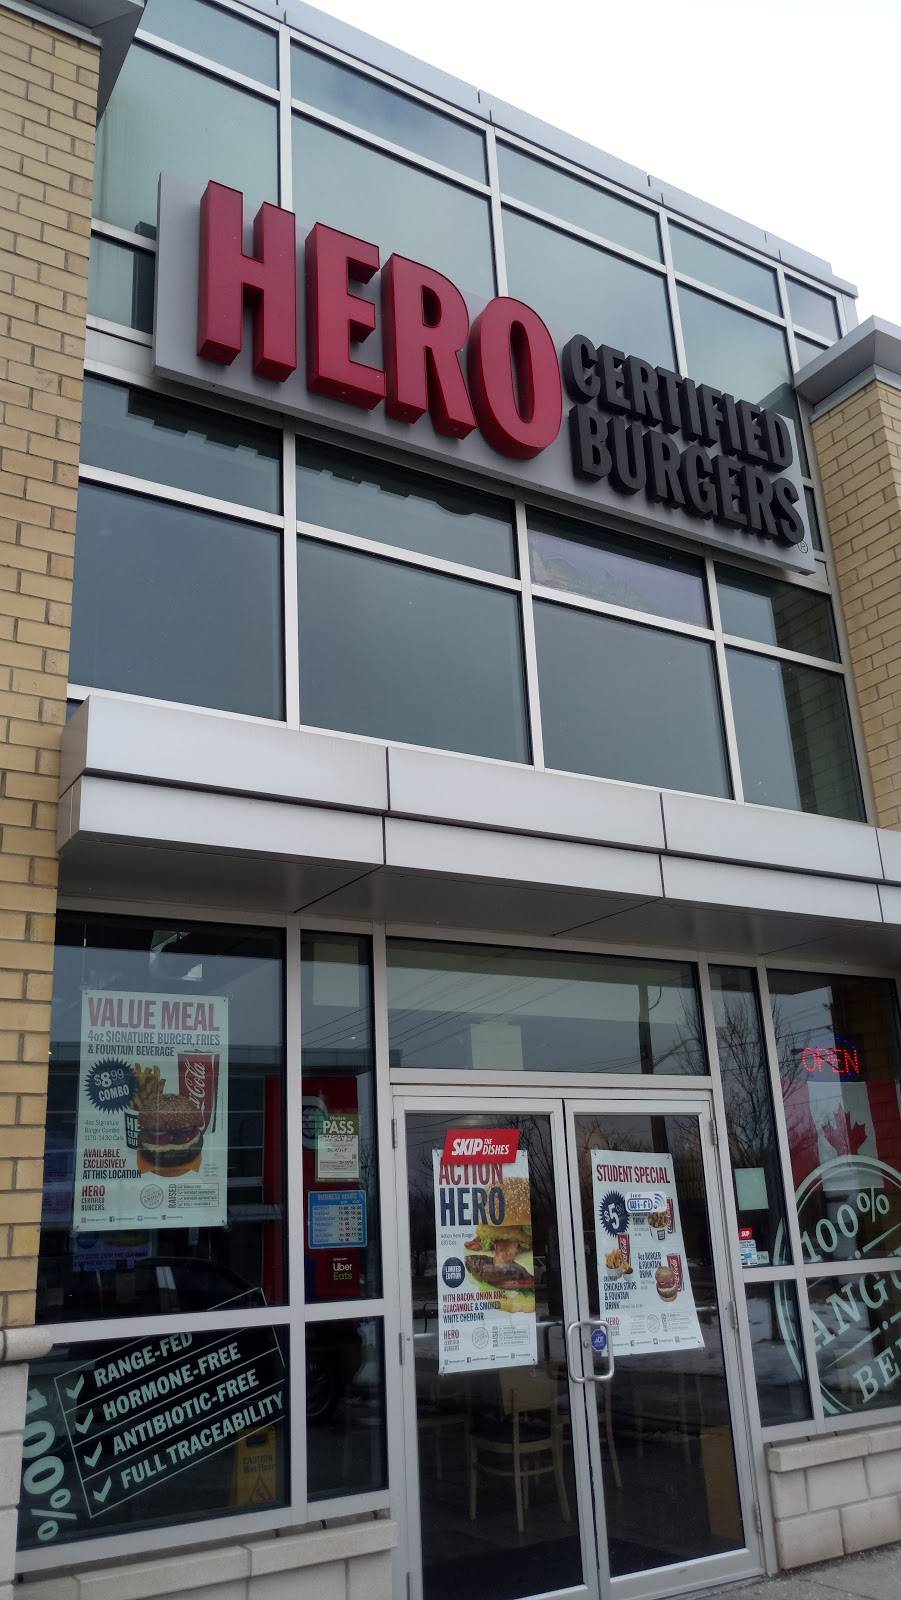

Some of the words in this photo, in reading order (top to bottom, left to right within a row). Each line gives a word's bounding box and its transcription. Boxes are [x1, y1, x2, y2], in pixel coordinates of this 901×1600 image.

[198, 180, 563, 460] HERO
[562, 334, 793, 472] CERTIFIED
[568, 404, 806, 548] BURGERS
[88, 997, 157, 1029] VALUE
[161, 1001, 220, 1031] MEAL
[105, 1030, 156, 1043] SIGNATURE
[157, 1032, 195, 1047] BURGER,
[196, 1034, 221, 1046] FRIES
[88, 1044, 94, 1054] &
[95, 1045, 135, 1056] FOUNTAIN
[136, 1046, 175, 1057] BEVERAGE
[801, 1047, 860, 1074] OPEN
[98, 1084, 130, 1101] COMBO
[322, 1120, 355, 1134] PASS
[83, 1149, 120, 1158] AVAILABLE
[451, 1138, 484, 1156] SKIP
[482, 1144, 510, 1155] DISHES
[83, 1158, 127, 1169] EXCLUSIVELY
[439, 1162, 504, 1185] ACTION
[82, 1170, 90, 1180] AT
[91, 1169, 107, 1180] THIS
[108, 1169, 142, 1180] LOCATION
[596, 1164, 632, 1183] STUDENT
[634, 1166, 671, 1184] SPECIAL
[81, 1185, 106, 1197] HERO
[440, 1187, 505, 1226] HERO
[332, 1262, 352, 1271] Uber
[443, 1329, 460, 1340] HERO
[93, 1331, 193, 1388] RANGE-FED
[102, 1342, 242, 1421] HORMONE-FREE
[853, 1338, 901, 1405] BE
[112, 1368, 260, 1456] ANTIBIOTIC-FREE
[120, 1454, 168, 1489] FULL
[166, 1390, 285, 1465] TRACEABILITY
